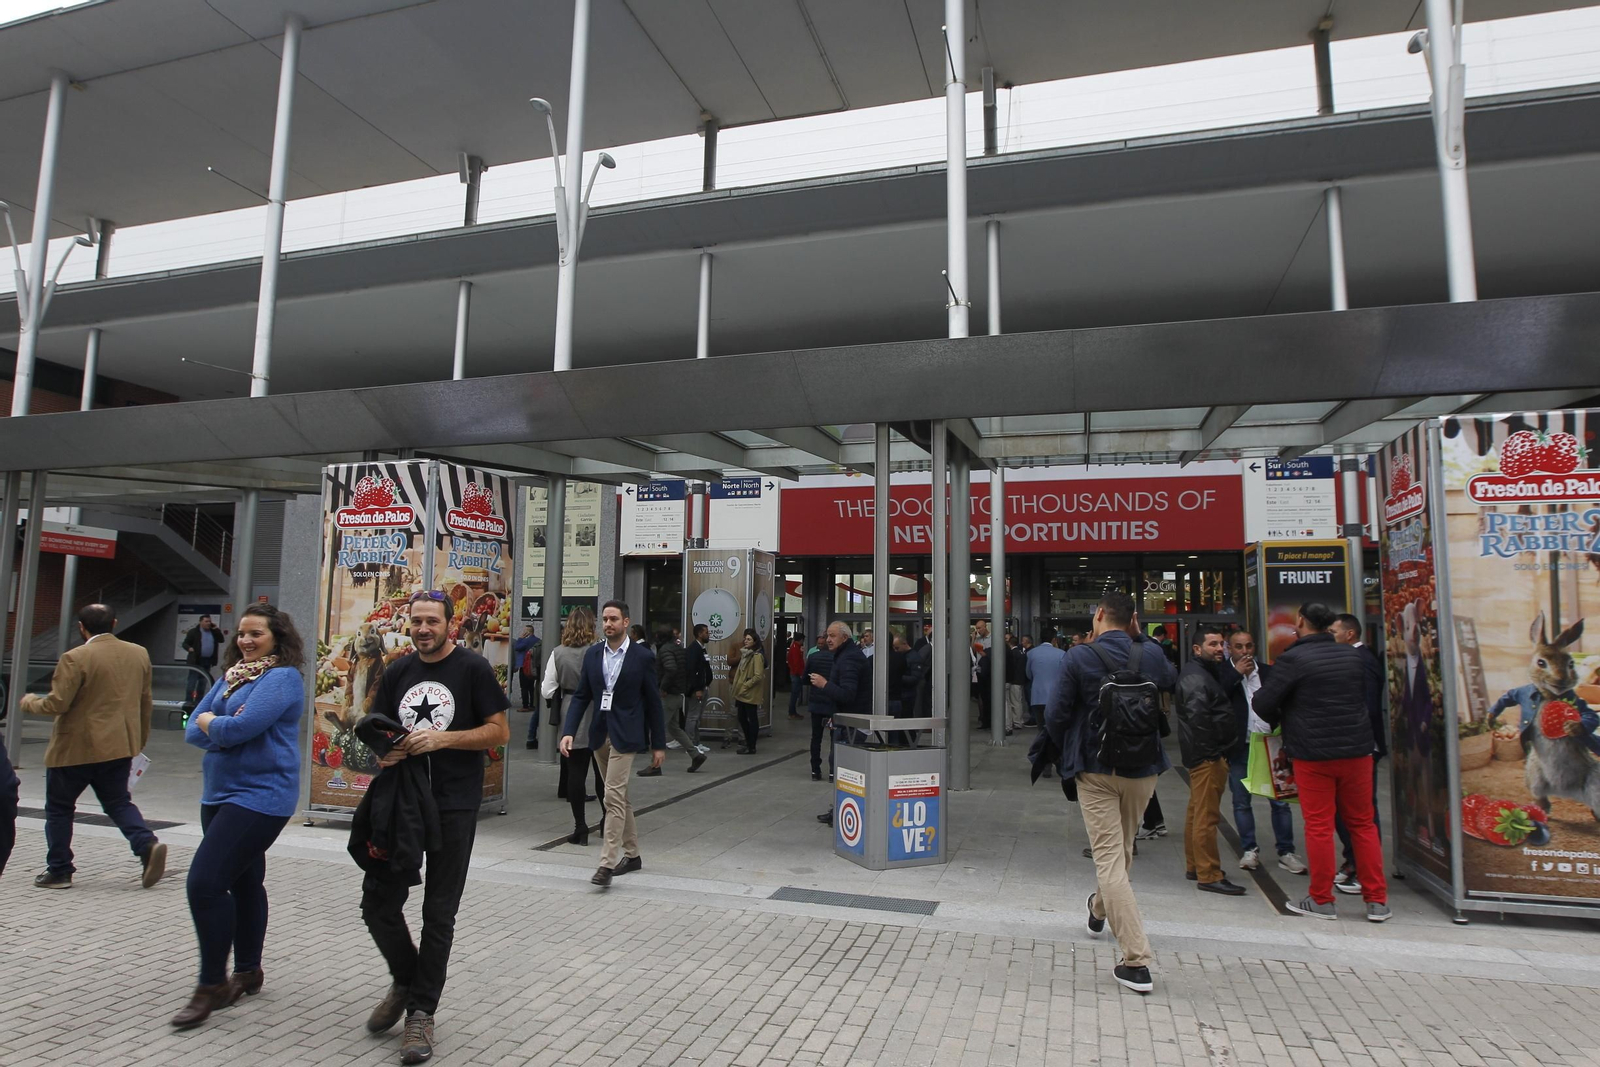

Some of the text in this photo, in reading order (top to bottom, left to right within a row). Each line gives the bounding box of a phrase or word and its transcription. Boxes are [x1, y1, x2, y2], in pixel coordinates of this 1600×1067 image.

[1287, 461, 1309, 469] South
[1474, 478, 1600, 498] Fresón de Palo
[833, 499, 875, 518] THE
[1008, 490, 1169, 514] THOUSANDS
[1177, 489, 1216, 511] OF
[339, 510, 410, 525] Fresón de Palos
[450, 513, 504, 534] Fresón de Palos
[1486, 511, 1586, 534] PETER
[338, 532, 408, 568] RABBIT 2
[342, 535, 392, 551] PETER
[452, 536, 490, 556] PETER
[1480, 533, 1593, 559] RABBIT
[448, 541, 502, 574] RABBIT 2
[1284, 552, 1301, 561] piace
[1308, 551, 1335, 561] mango?
[693, 559, 724, 567] PABELLÓN
[727, 556, 741, 579] 9
[693, 566, 724, 574] PAVILION
[1513, 562, 1541, 571] SOLO
[1543, 562, 1556, 571] EN
[1279, 571, 1332, 584] FRUNET
[712, 654, 728, 664] gust
[712, 671, 727, 680] icos
[401, 687, 424, 709] PUNK
[427, 686, 451, 707] ROCK
[892, 801, 926, 828] ¿LO
[902, 826, 936, 853] VE?
